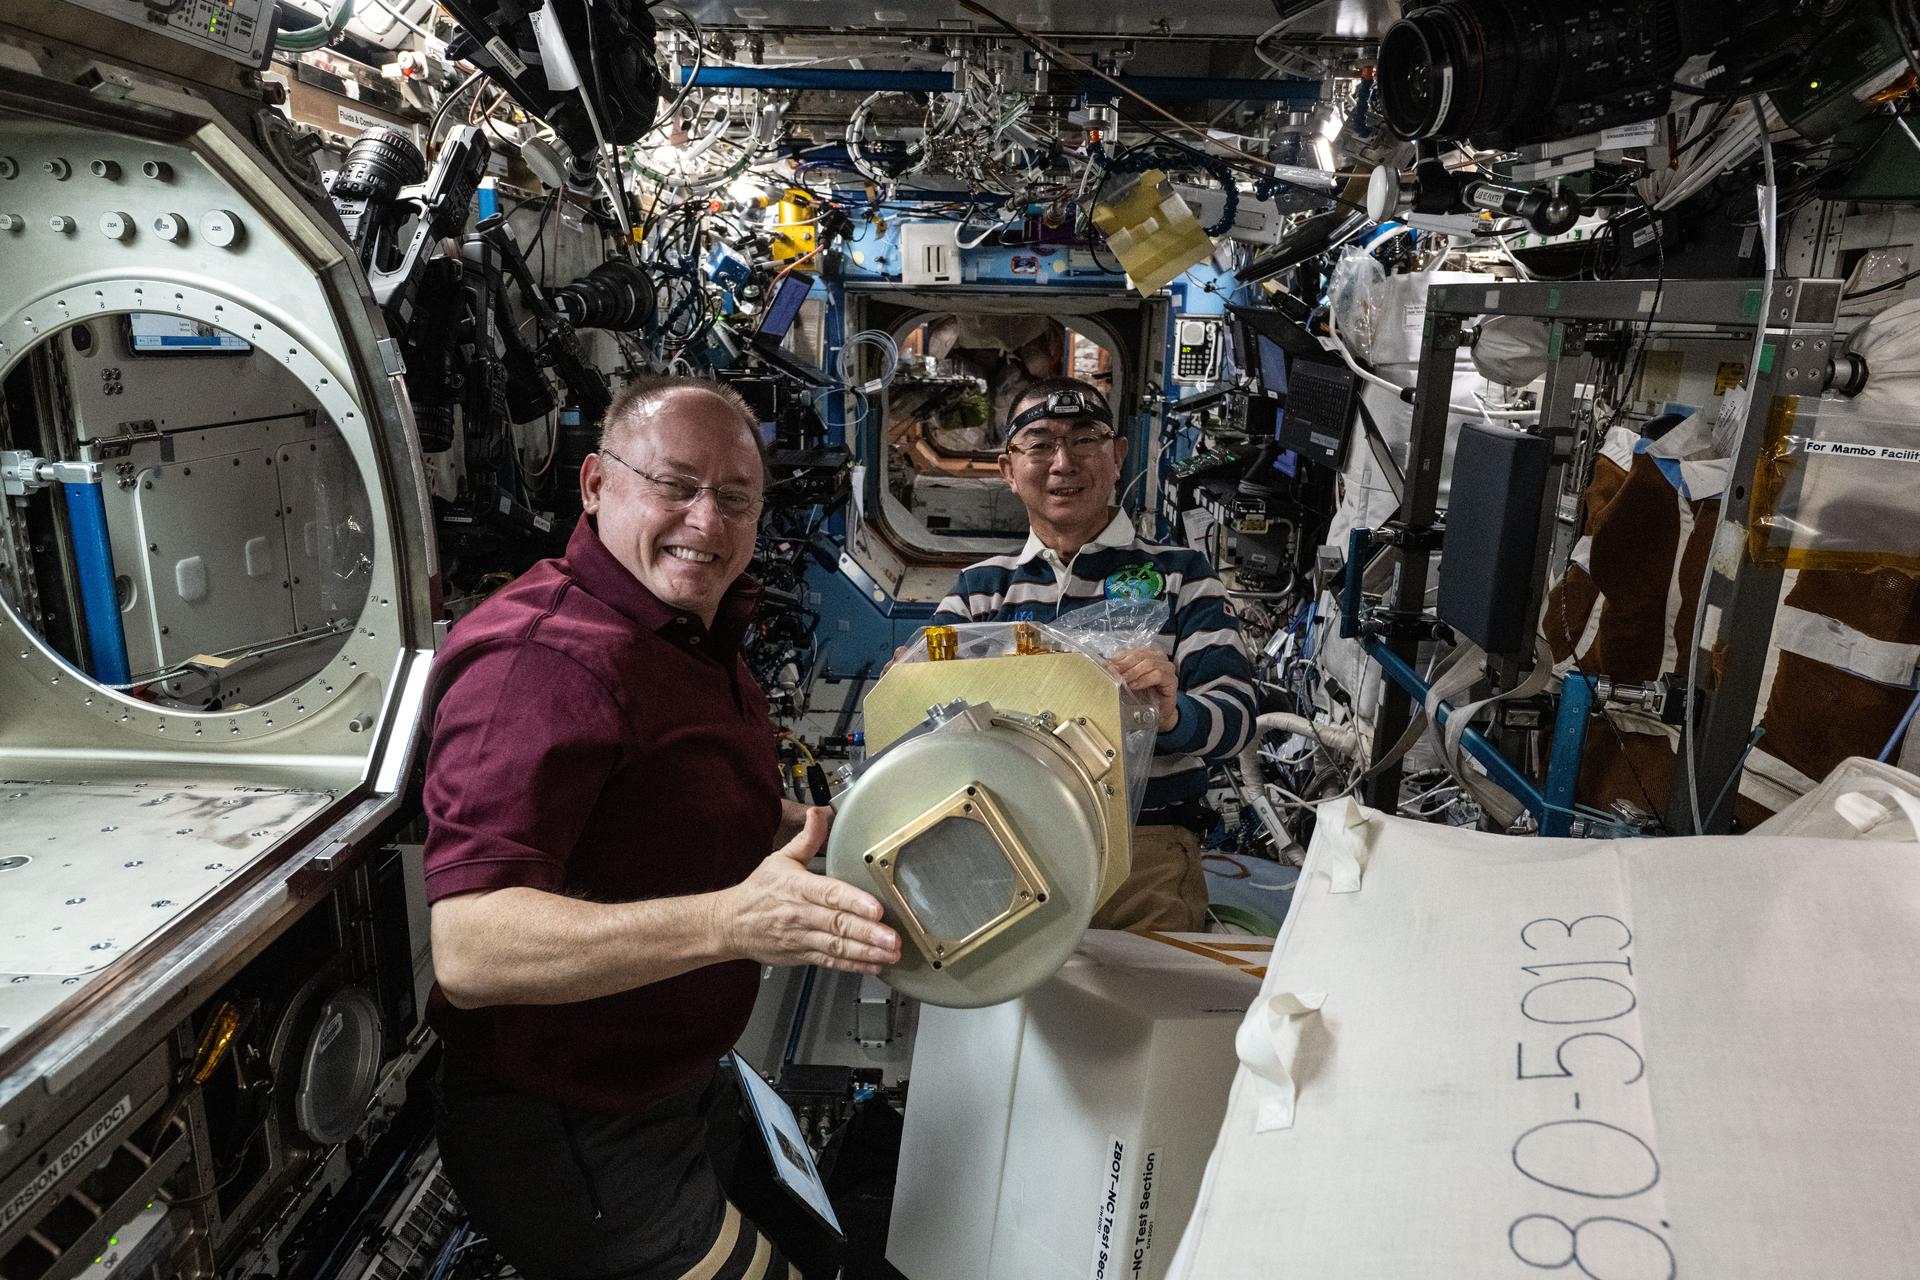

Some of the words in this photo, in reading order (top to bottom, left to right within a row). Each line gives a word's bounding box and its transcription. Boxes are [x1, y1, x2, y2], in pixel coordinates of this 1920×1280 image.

[1690, 64, 1726, 85] Canon
[64, 310, 69, 318] 9
[100, 301, 105, 309] 8
[176, 303, 181, 311] 6
[32, 326, 39, 334] 10
[1806, 442, 1827, 451] For
[1831, 444, 1876, 456] Mambo
[0, 1166, 60, 1227] ERSION
[61, 1137, 90, 1170] BOX
[91, 1103, 127, 1142] (PDC)
[1140, 1152, 1155, 1210] Section
[1101, 1217, 1113, 1249] Test
[1135, 1213, 1148, 1246] Test
[1096, 1250, 1108, 1280] Sec
